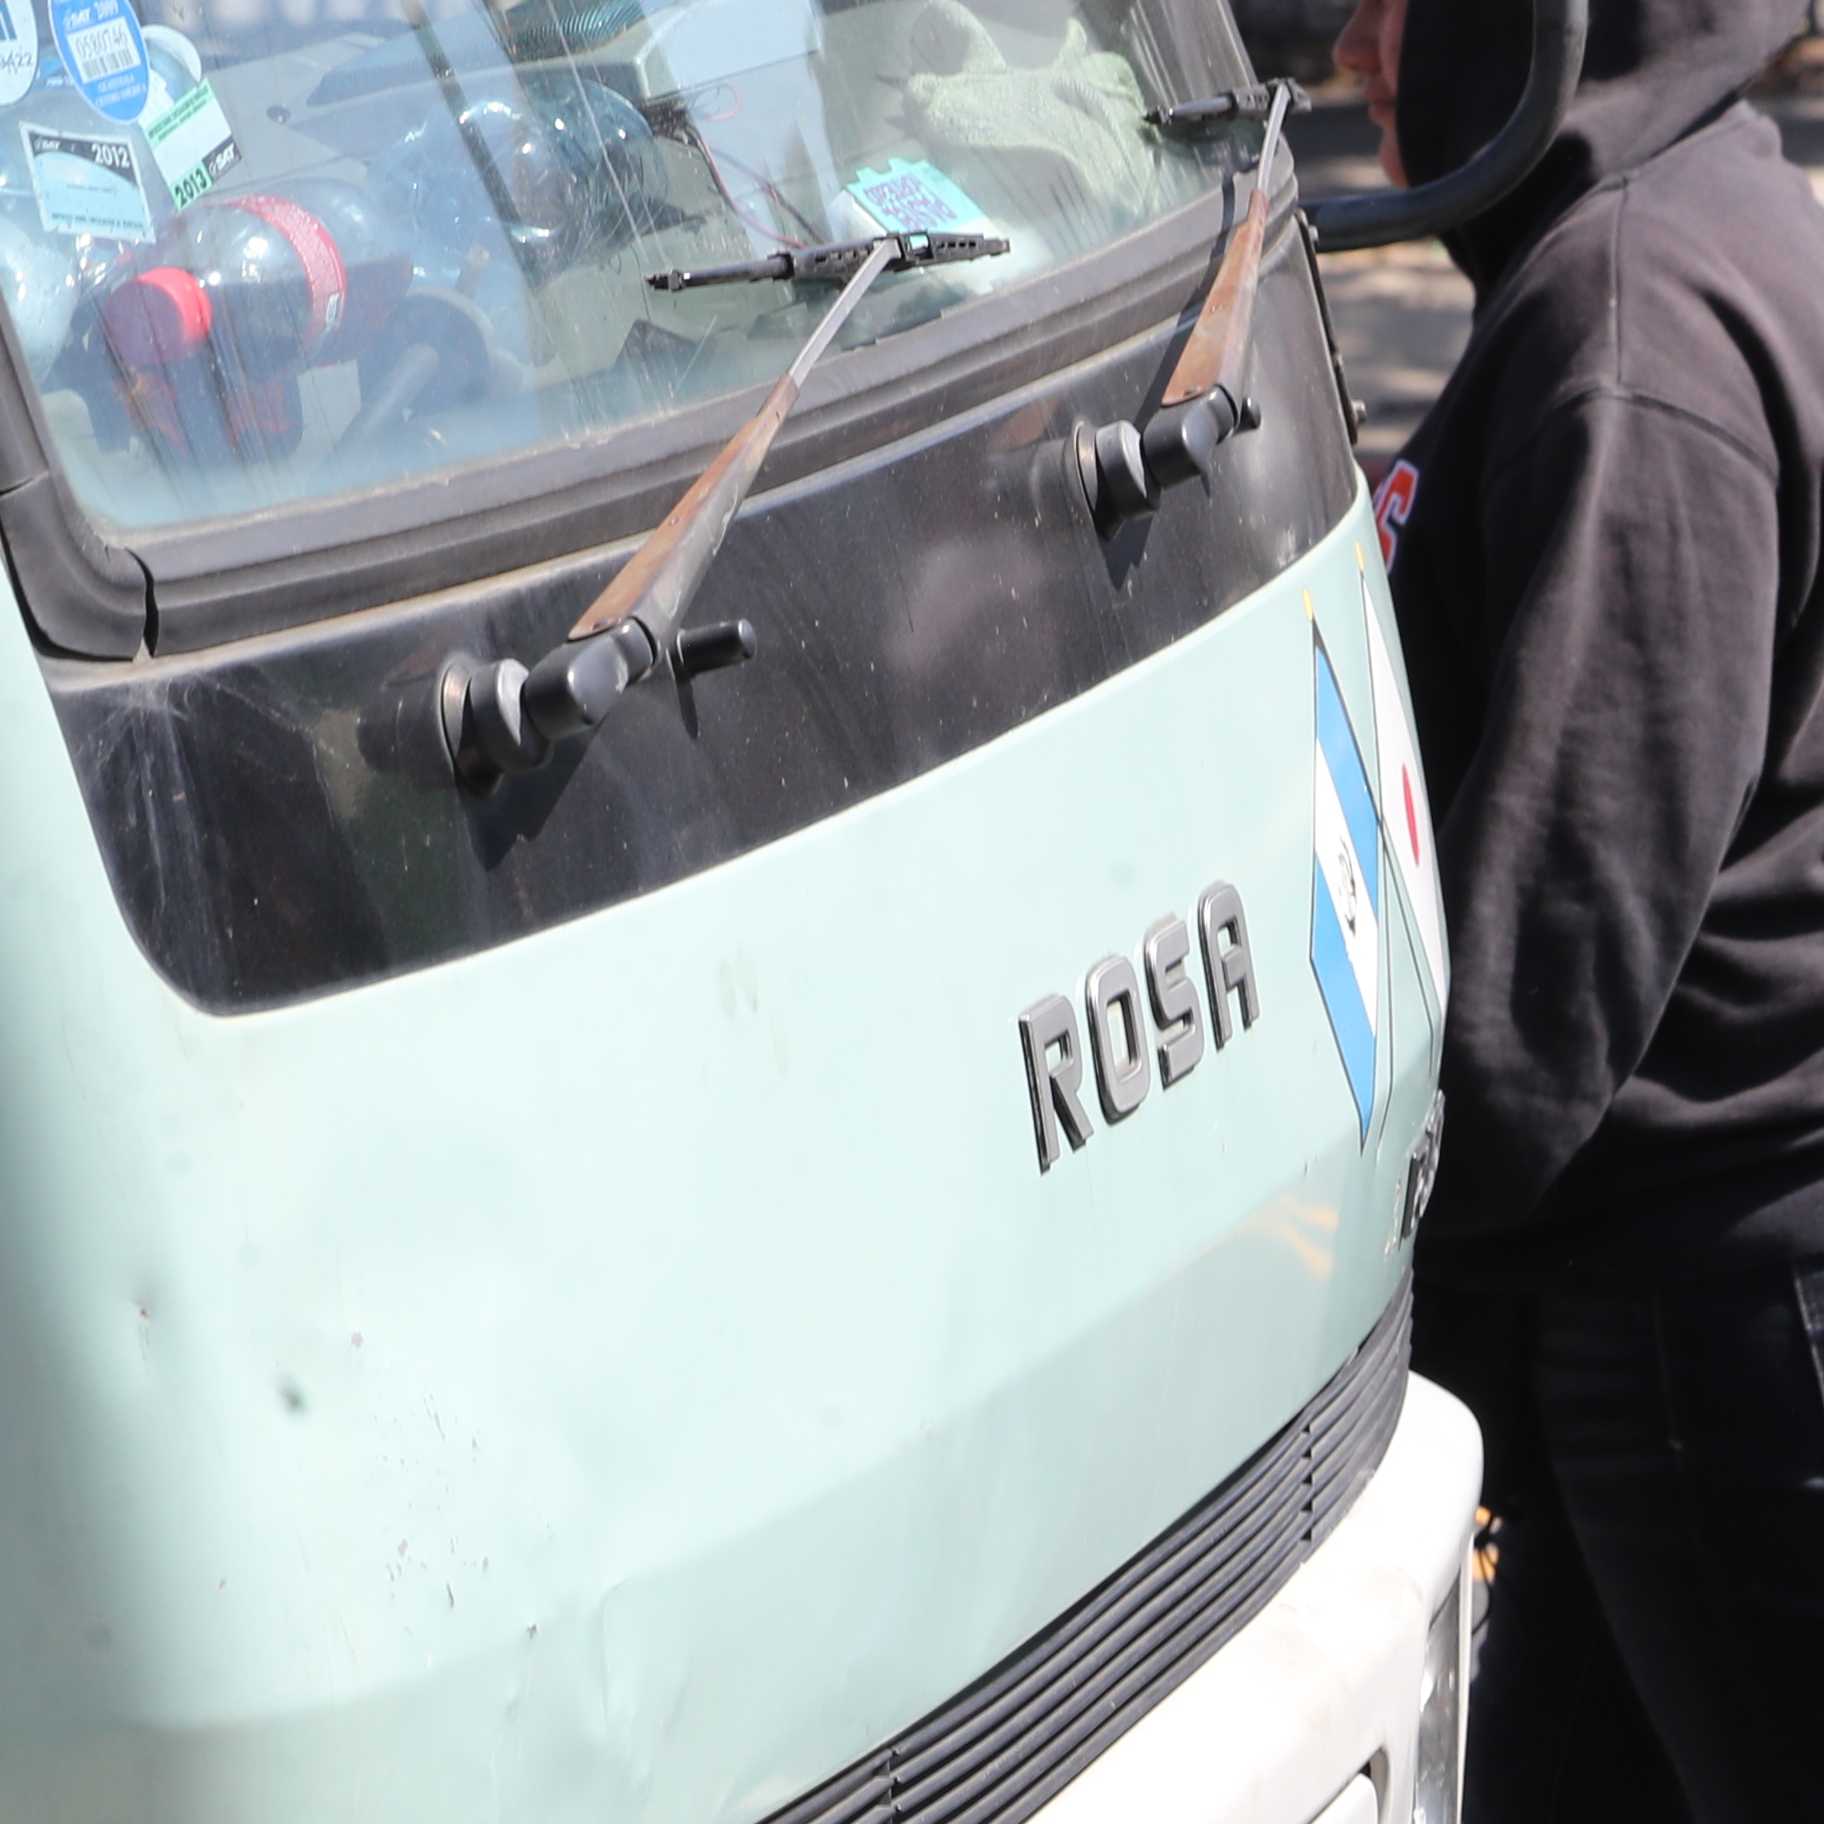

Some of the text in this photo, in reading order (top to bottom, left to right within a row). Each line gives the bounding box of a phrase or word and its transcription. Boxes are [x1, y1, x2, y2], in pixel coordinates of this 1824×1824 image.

[91, 143, 131, 169] 2012
[174, 169, 209, 208] 2013
[1018, 880, 1260, 1176] ROSA
